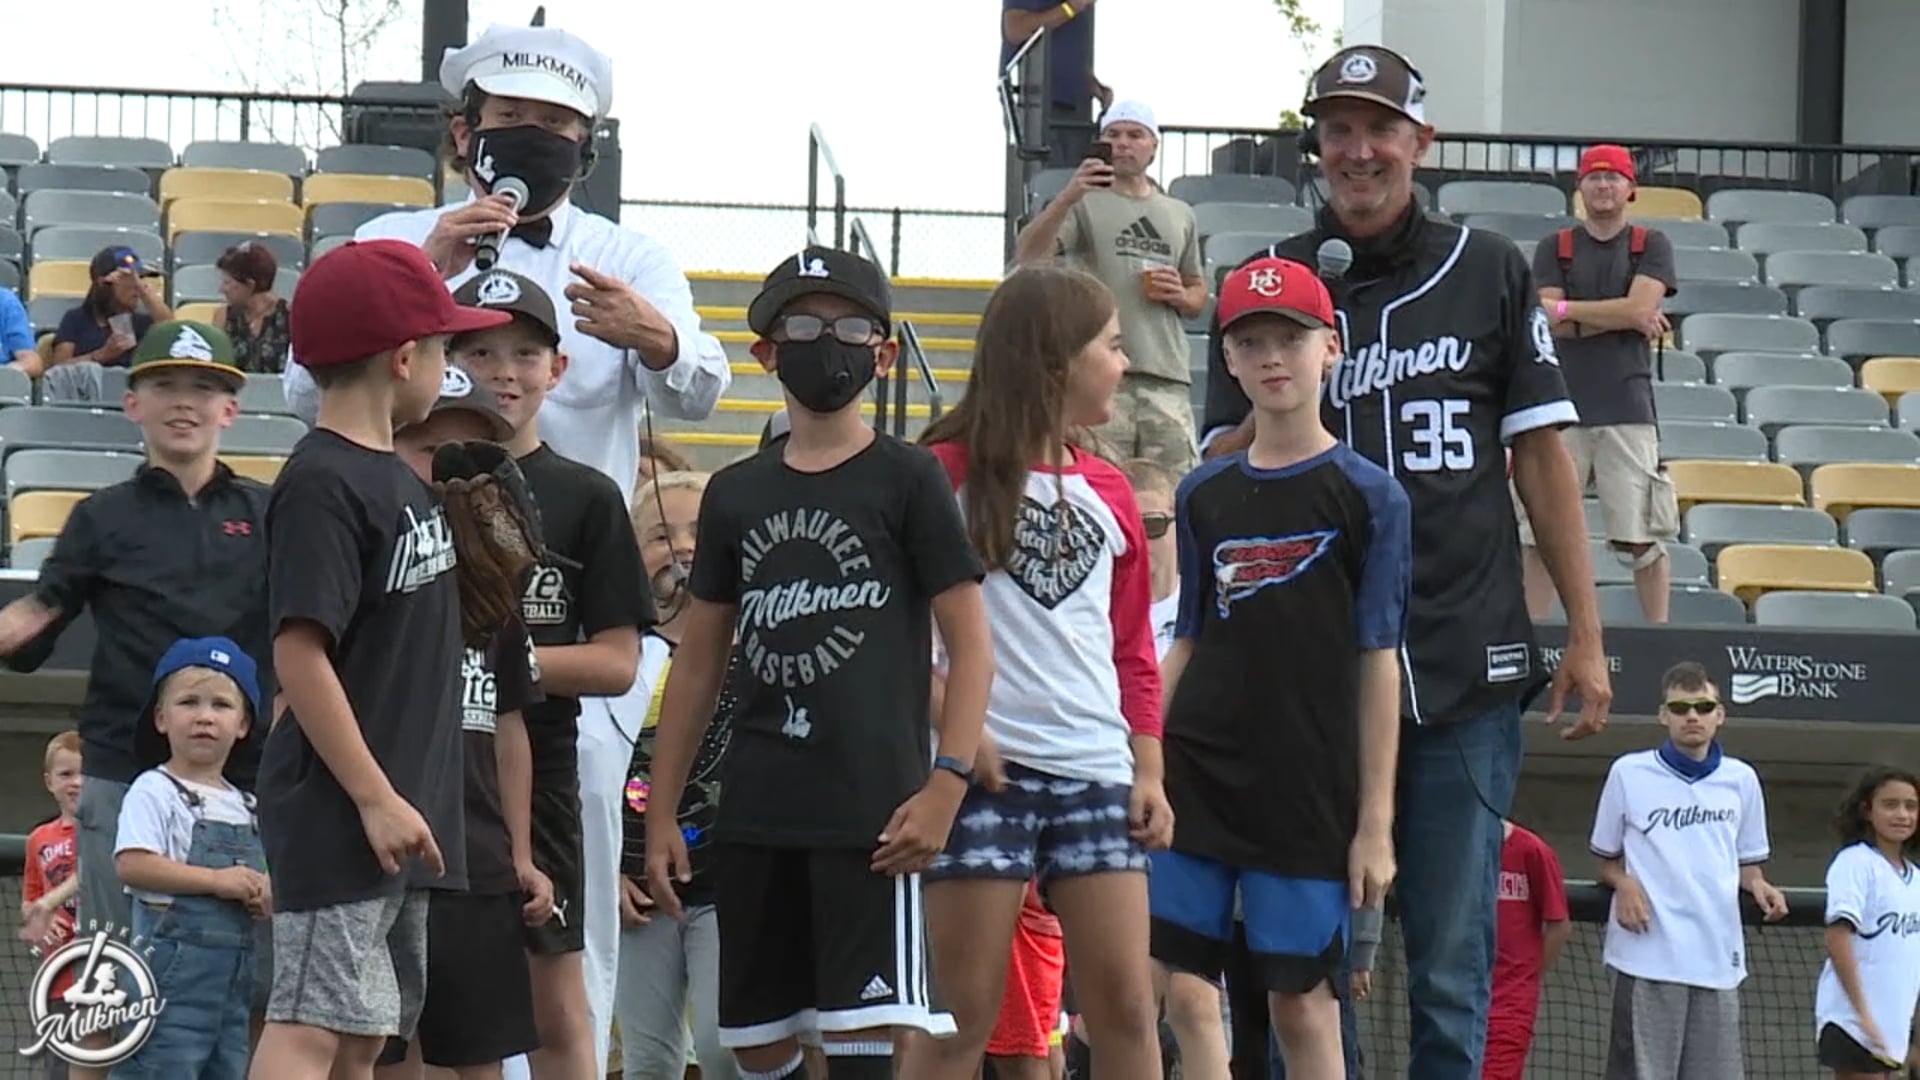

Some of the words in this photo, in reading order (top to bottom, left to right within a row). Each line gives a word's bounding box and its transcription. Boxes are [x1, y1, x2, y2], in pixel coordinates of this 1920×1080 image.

[503, 52, 587, 91] MILKMAN
[1115, 236, 1171, 256] adidas
[1401, 399, 1475, 472] 35
[741, 507, 871, 583] MILWAUKEE
[738, 578, 891, 638] Milkmen
[745, 625, 865, 688] BASEBALL
